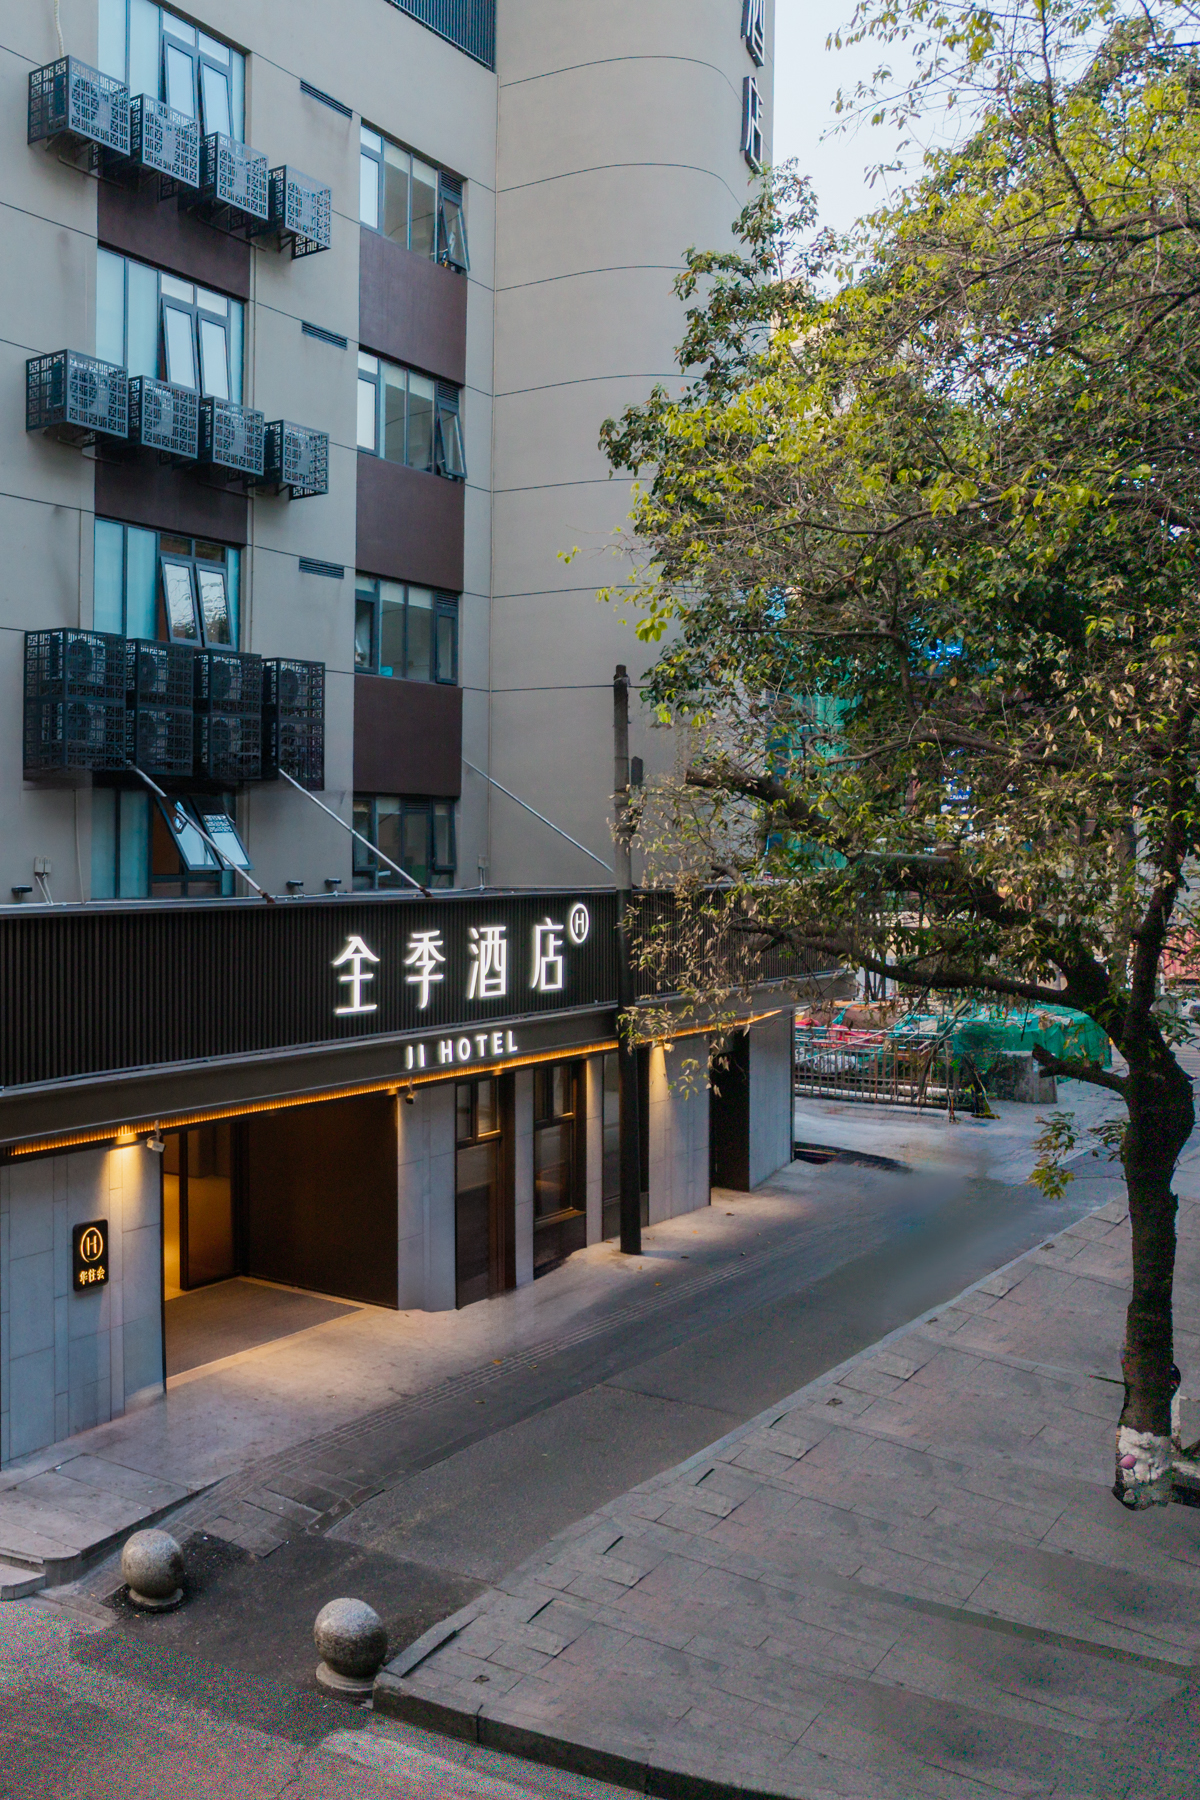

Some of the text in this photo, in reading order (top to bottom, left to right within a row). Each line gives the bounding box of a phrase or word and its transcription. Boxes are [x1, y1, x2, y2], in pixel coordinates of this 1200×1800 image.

[332, 917, 565, 1015] 全季酒店
[405, 1030, 519, 1070] JI HOTEL
[79, 1265, 105, 1285] 华住会
